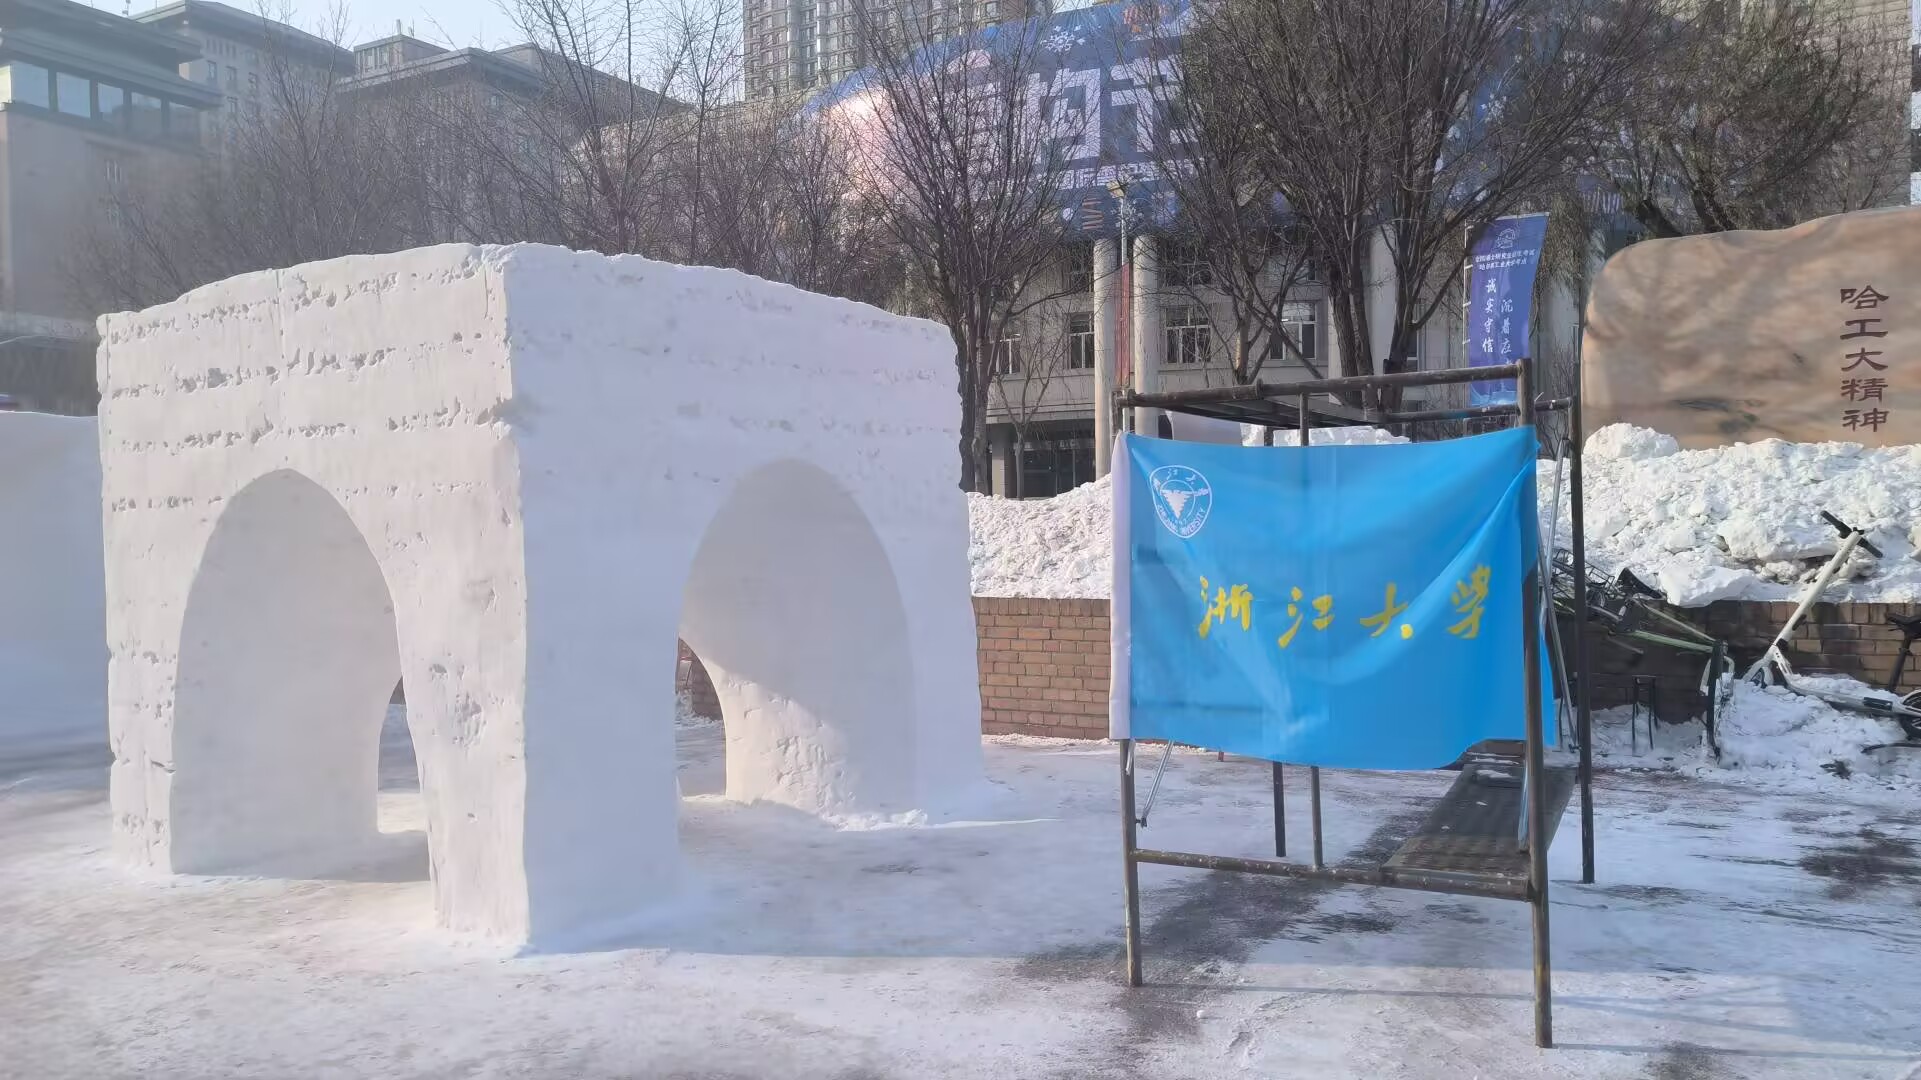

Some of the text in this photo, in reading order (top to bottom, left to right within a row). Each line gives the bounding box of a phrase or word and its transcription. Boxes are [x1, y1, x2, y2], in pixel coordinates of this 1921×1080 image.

[1482, 278, 1497, 353] 诚实守信
[1500, 299, 1514, 366] 沉着应
[1840, 285, 1890, 433] 哈工大精神
[1198, 563, 1492, 649] 浙江大学
